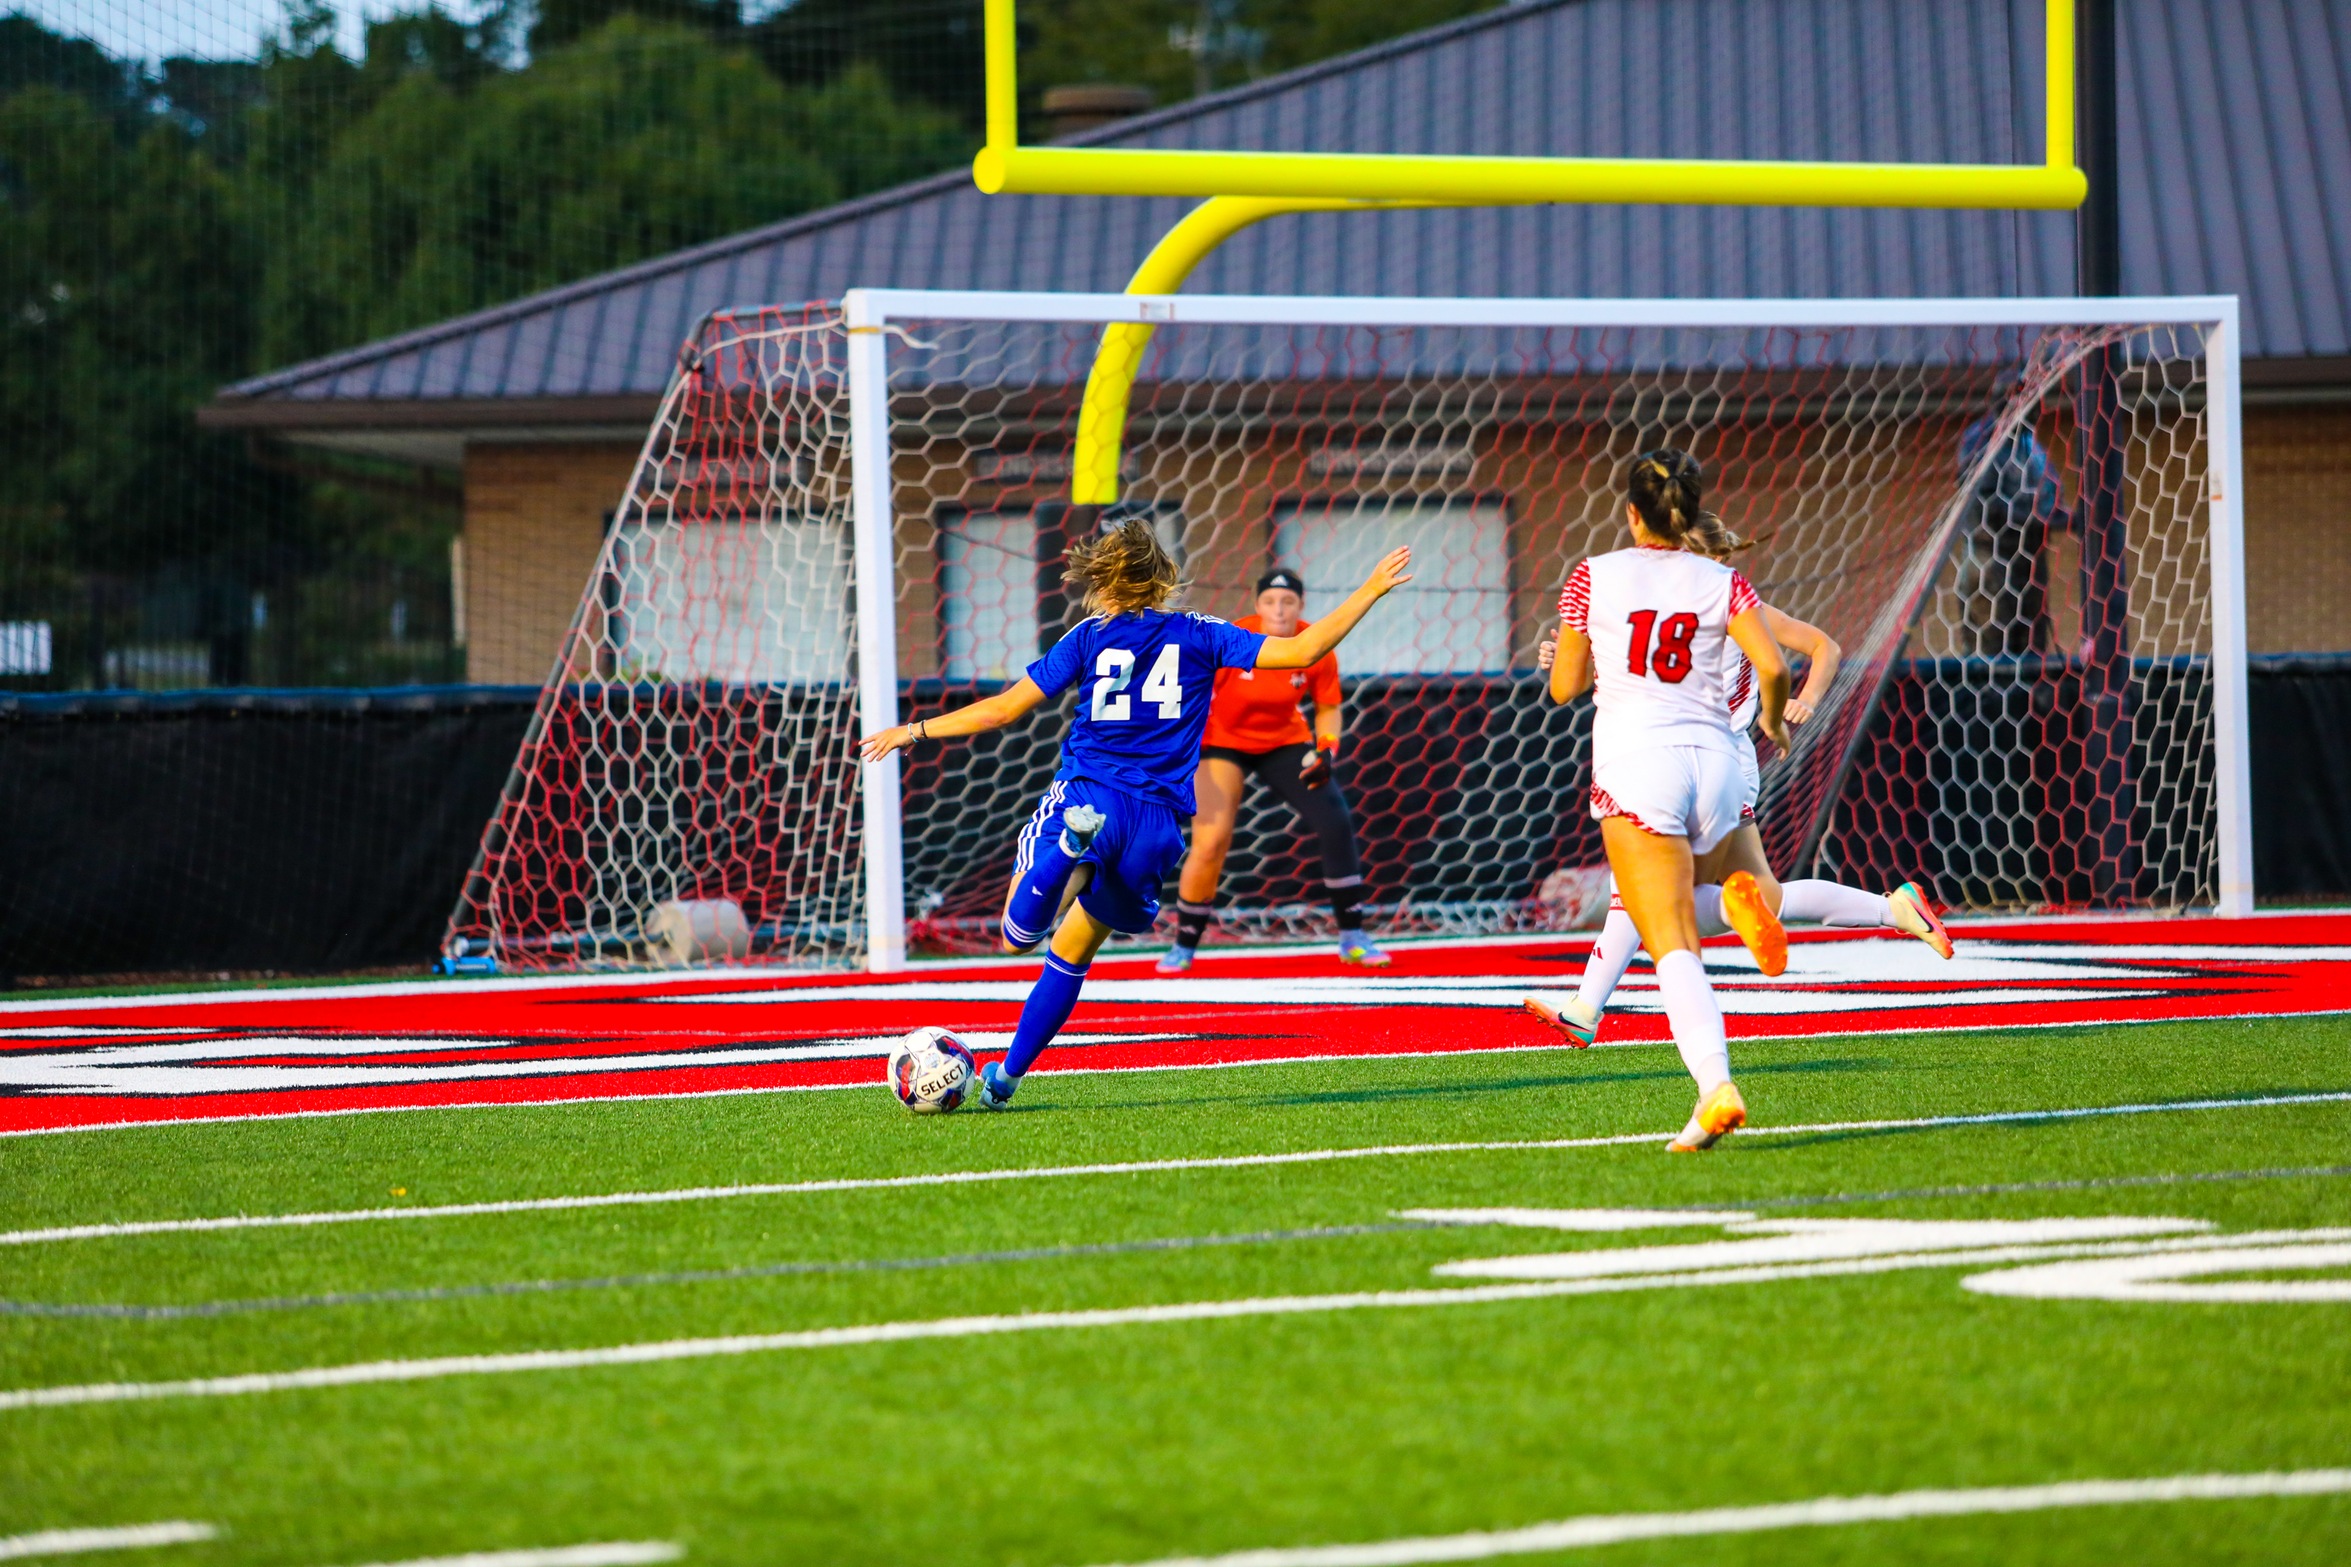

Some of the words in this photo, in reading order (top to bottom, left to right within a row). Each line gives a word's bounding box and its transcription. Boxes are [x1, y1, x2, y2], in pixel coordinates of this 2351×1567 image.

[1091, 644, 1182, 721] 24
[1627, 609, 1699, 684] 18
[921, 1064, 964, 1096] SELECT
